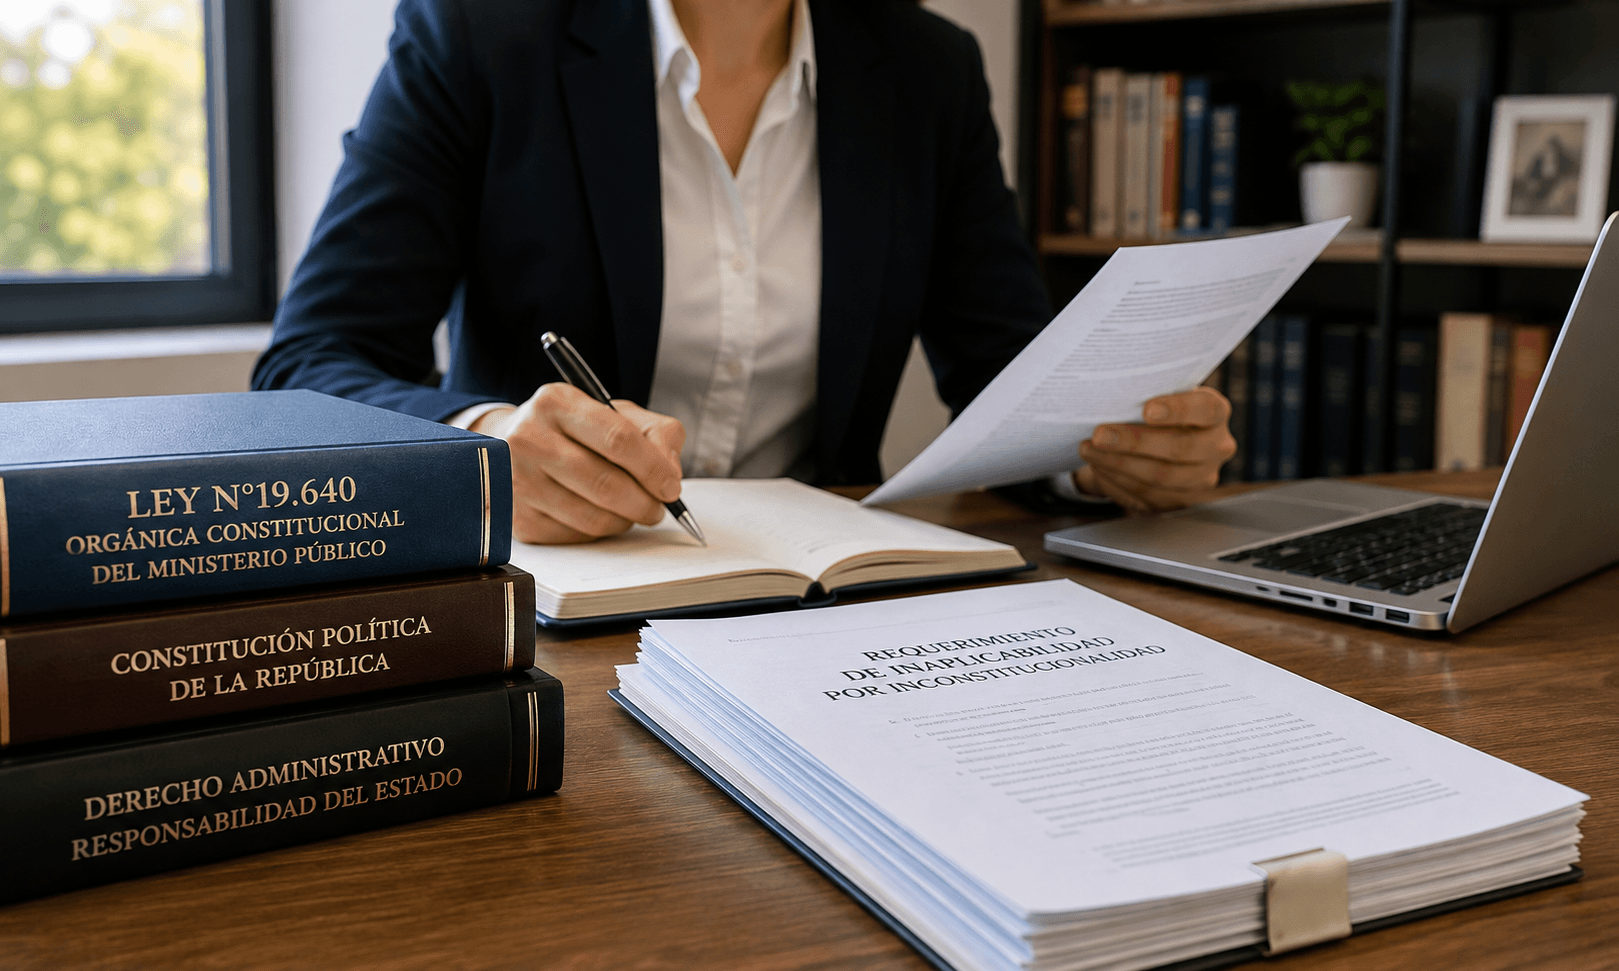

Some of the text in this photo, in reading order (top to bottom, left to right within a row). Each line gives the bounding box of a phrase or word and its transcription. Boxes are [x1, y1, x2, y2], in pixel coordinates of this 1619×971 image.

[127, 476, 357, 519] LEY N°19.640
[66, 509, 404, 555] ORGÁNICA CONSTITUCIONAL
[92, 540, 386, 585] DEL MINISTERIO PÚBLICO
[111, 616, 431, 675] CONSTITUCIÓN POLÍTICA
[839, 635, 1115, 683] DE INAPLICABILIDAD
[862, 626, 1076, 662] REQUERIMIENTO
[170, 654, 390, 701] DE LA REPÚBLICA
[822, 644, 1167, 702] POR INCONSTITUCIONALIDAD
[84, 736, 444, 820] DERECHO ADMINISTRATIVO
[72, 768, 463, 861] RESPONSABILIDAD DEL ESTADO
